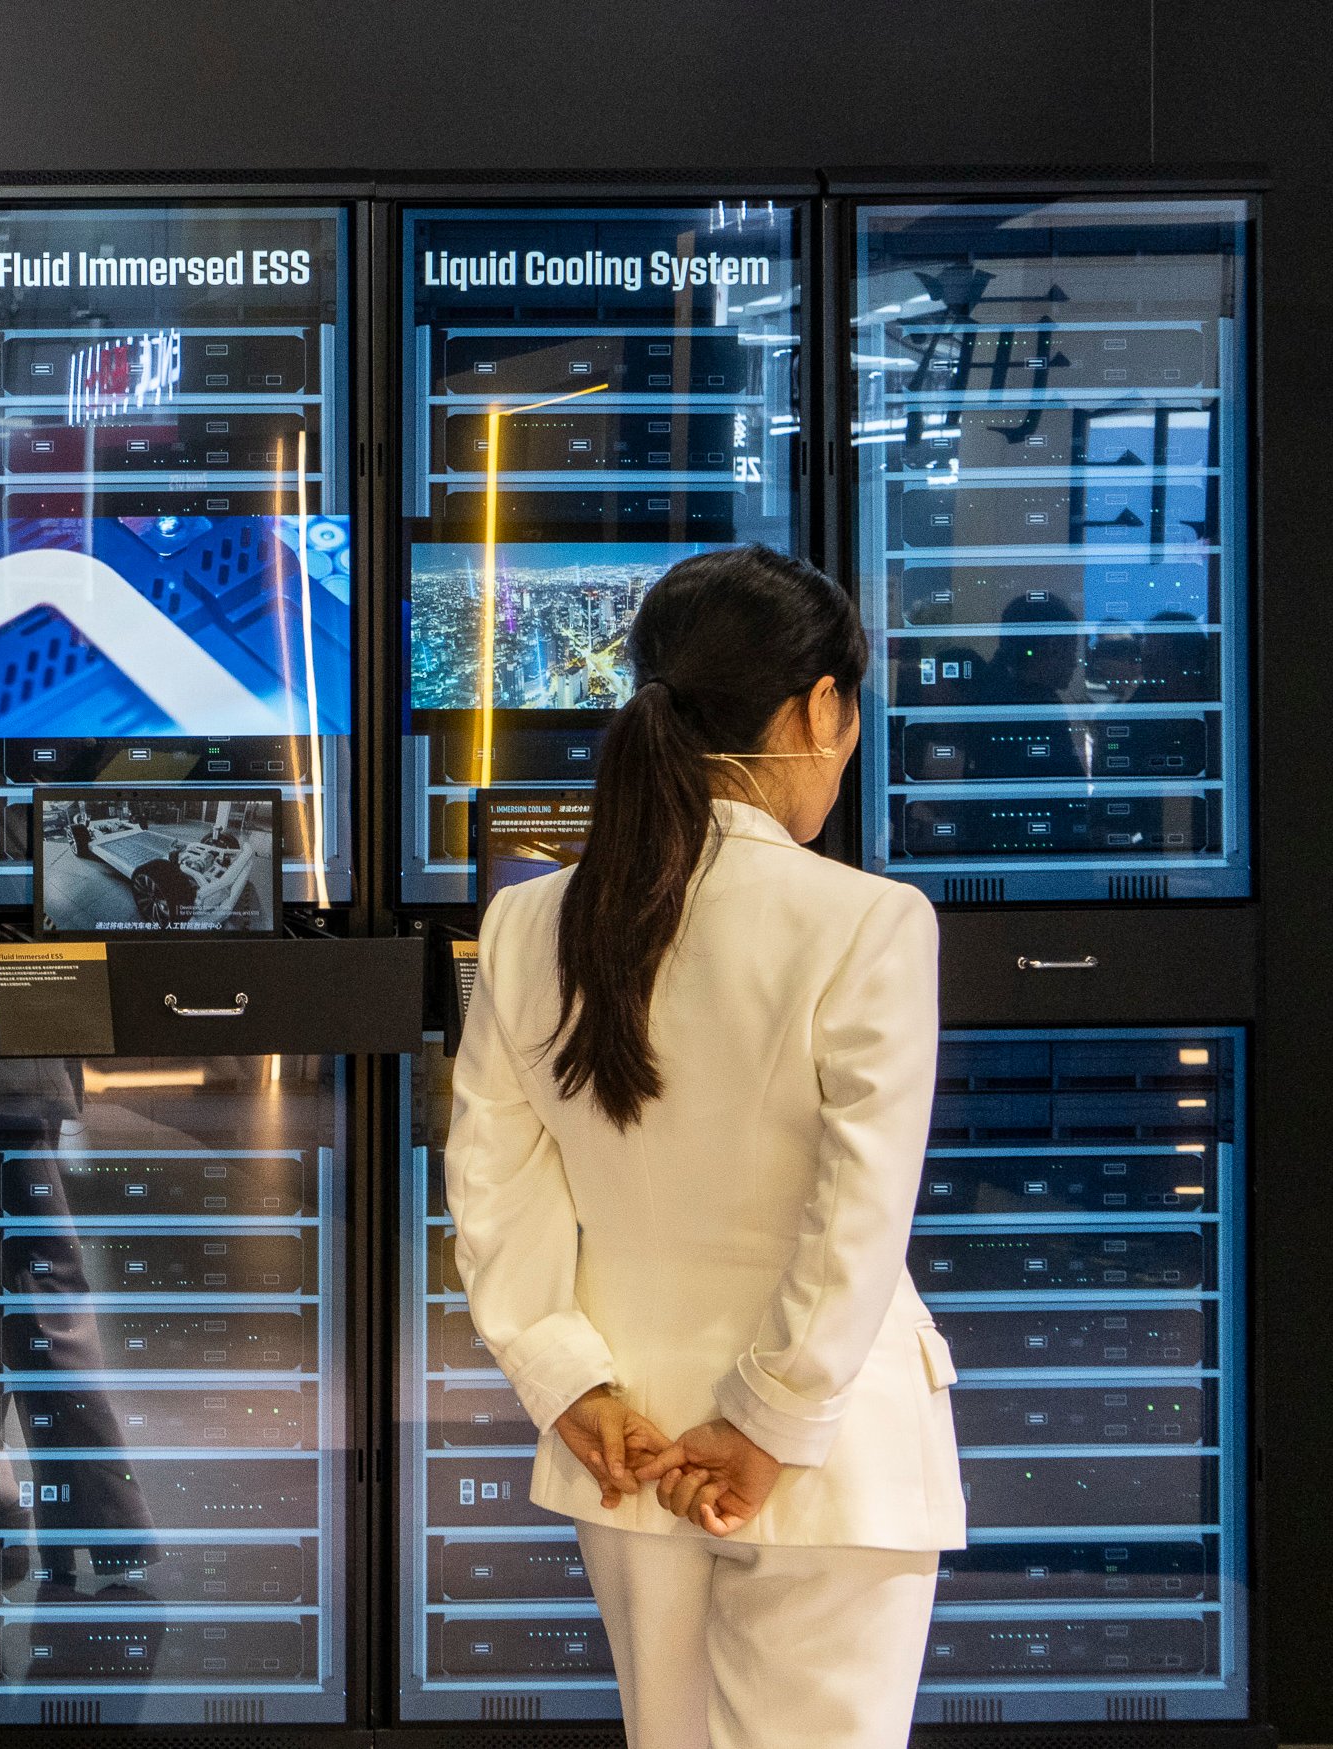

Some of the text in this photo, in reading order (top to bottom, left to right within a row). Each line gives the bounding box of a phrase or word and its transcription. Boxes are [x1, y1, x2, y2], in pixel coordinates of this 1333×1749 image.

[79, 251, 243, 286] Immersed
[253, 250, 310, 285] ESS
[424, 251, 770, 292] Liquid Cooling System
[496, 805, 527, 813] IMMERSION
[528, 805, 552, 813] COOLING
